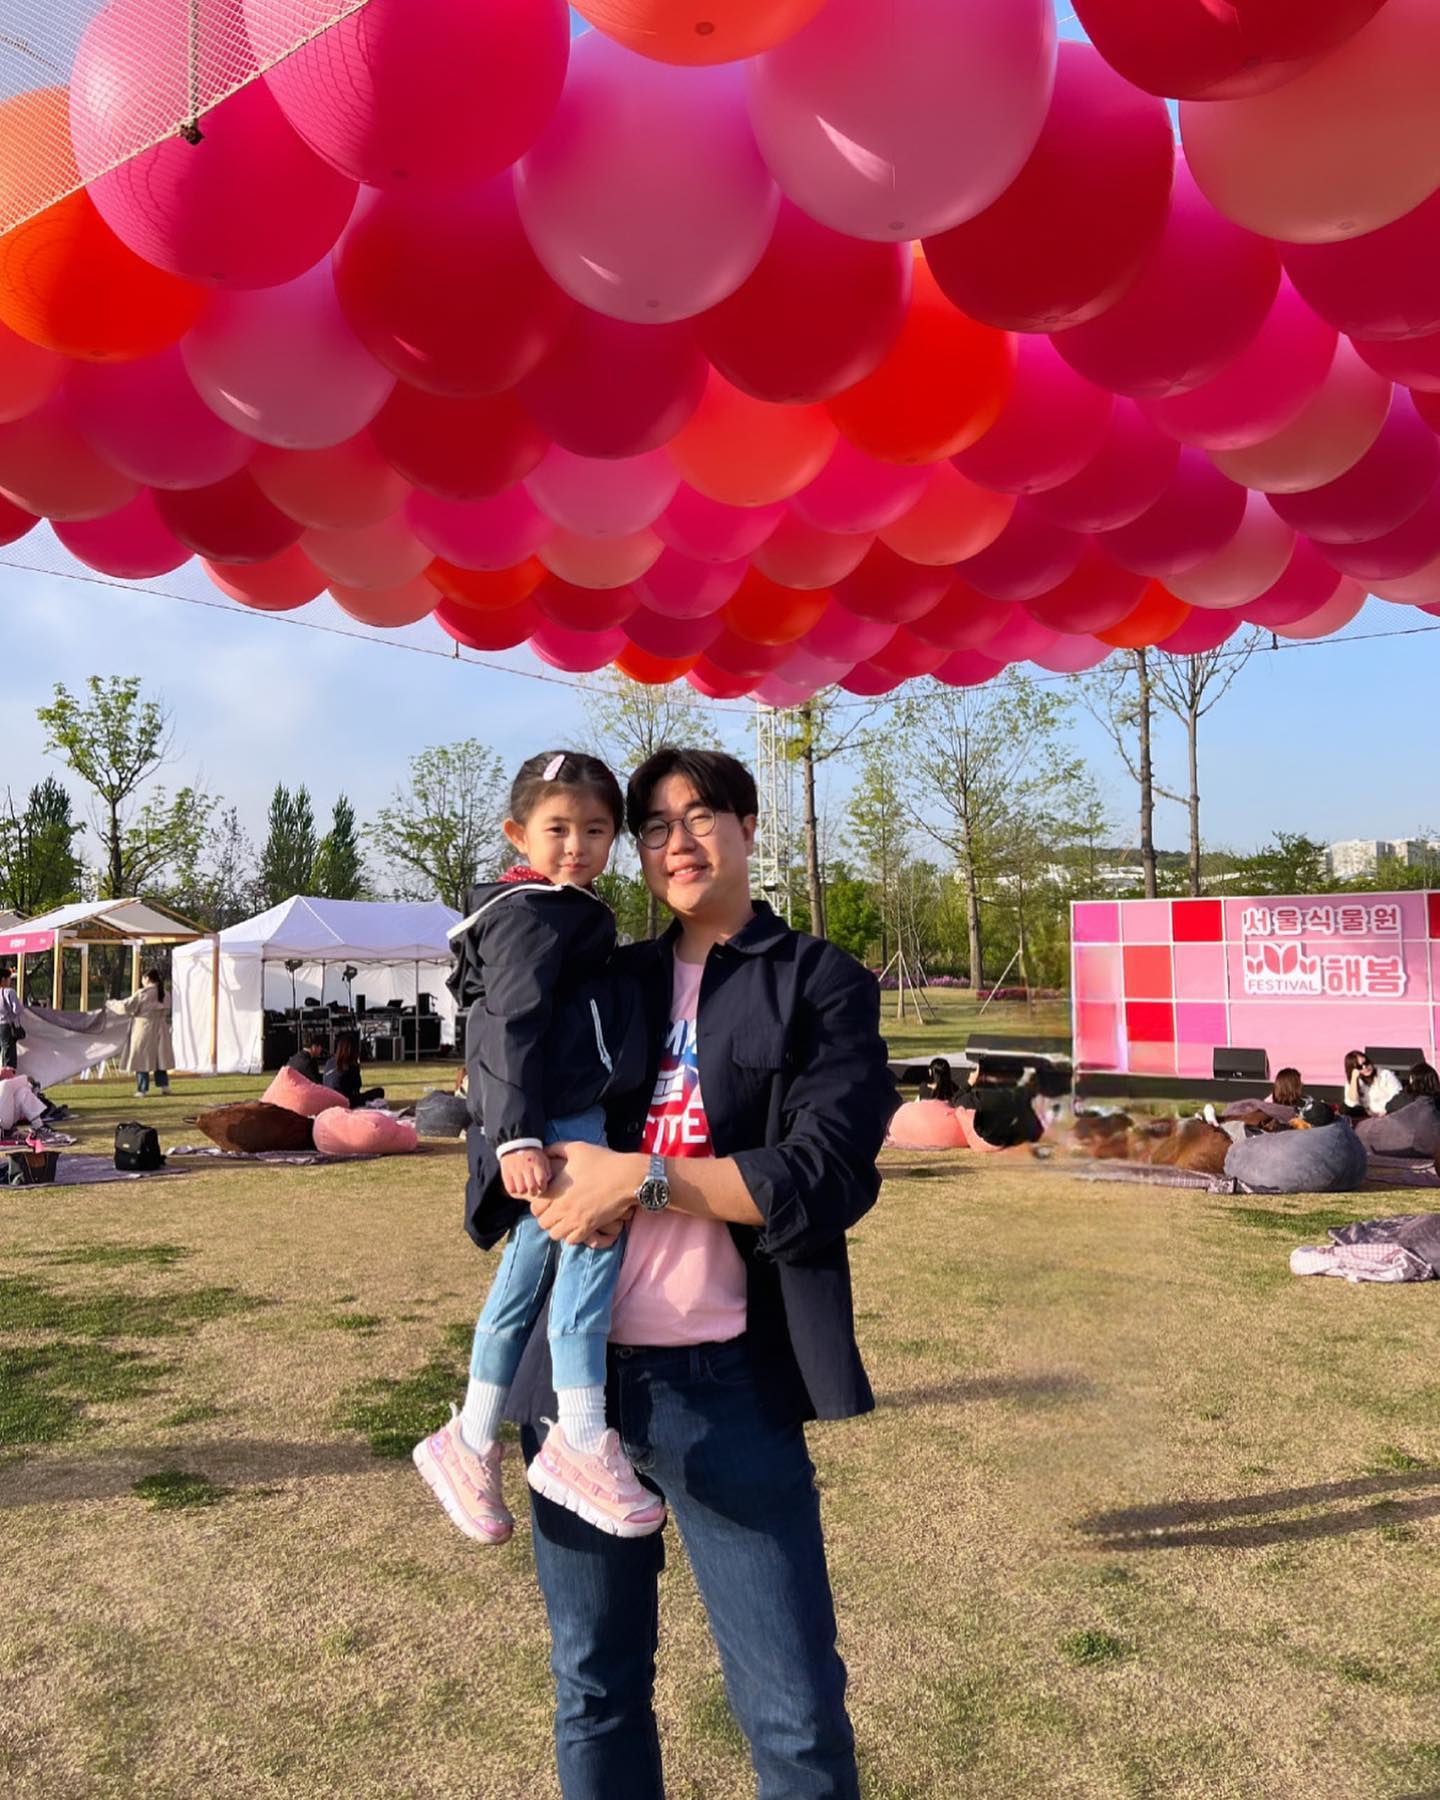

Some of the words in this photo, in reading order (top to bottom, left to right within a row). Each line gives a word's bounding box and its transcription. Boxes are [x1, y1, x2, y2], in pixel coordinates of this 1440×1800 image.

[1248, 906, 1397, 931] 서울식물원
[1249, 979, 1318, 992] FESTIVAL
[1326, 958, 1402, 993] 해봄
